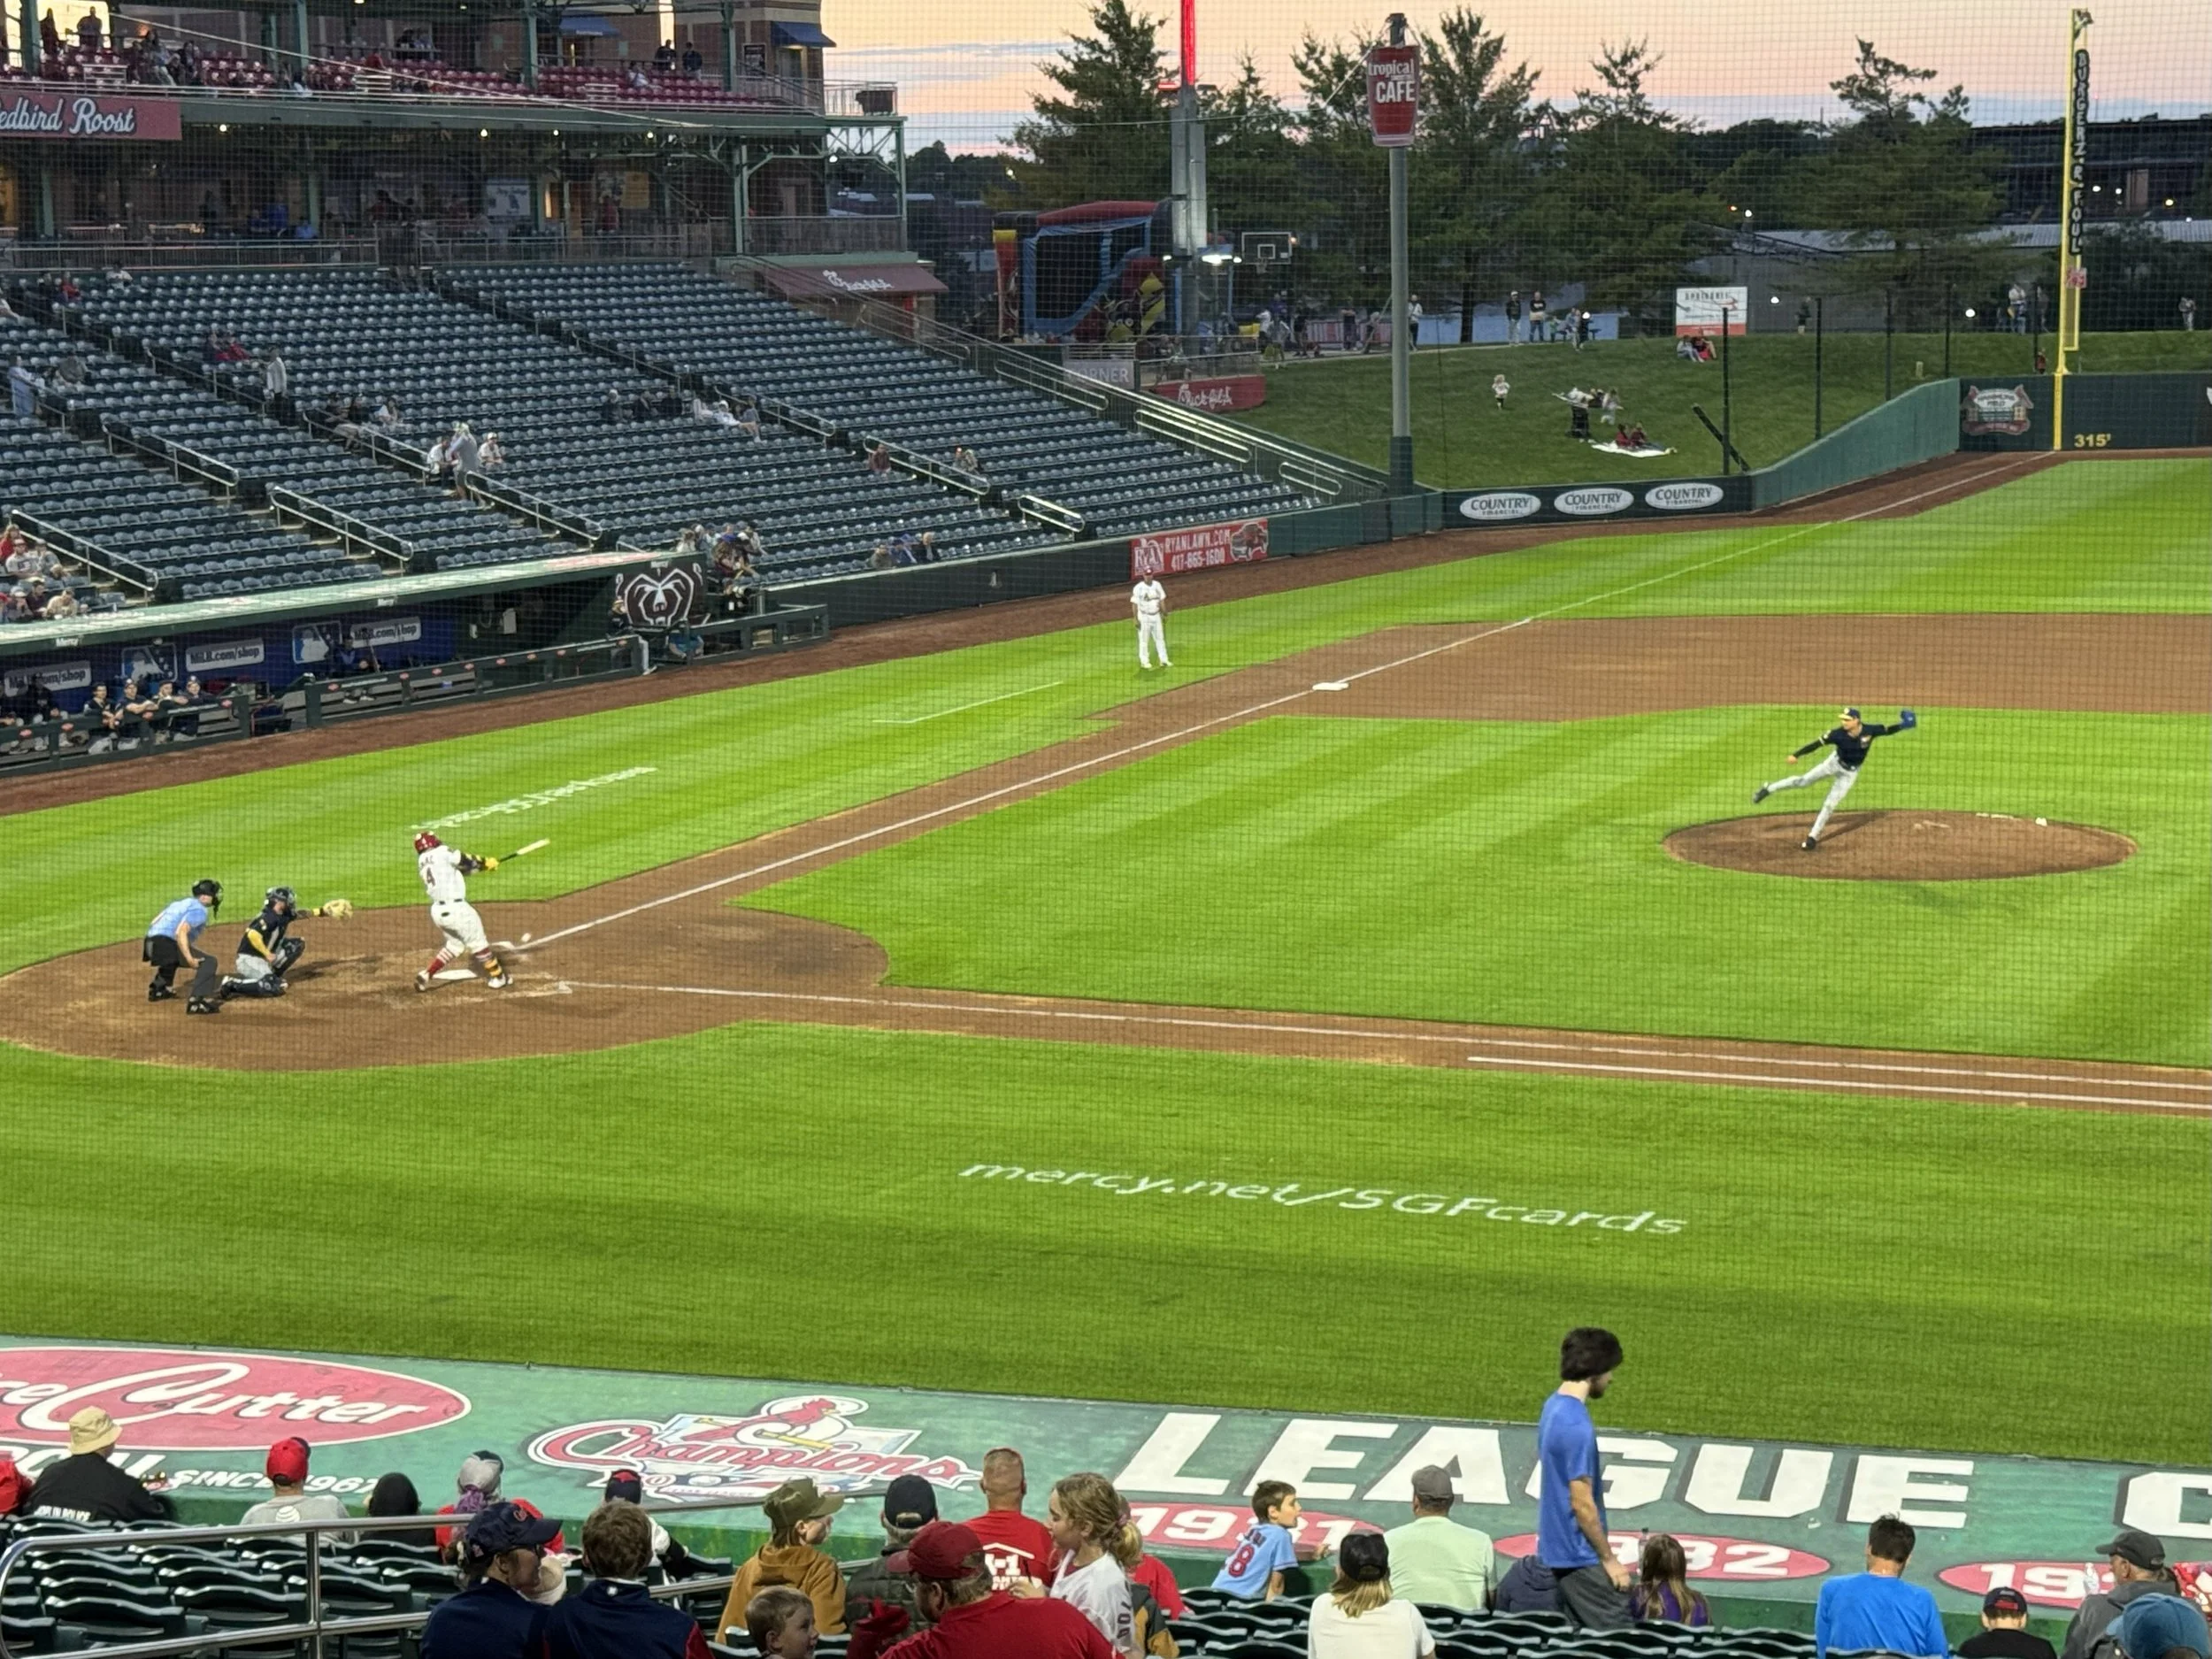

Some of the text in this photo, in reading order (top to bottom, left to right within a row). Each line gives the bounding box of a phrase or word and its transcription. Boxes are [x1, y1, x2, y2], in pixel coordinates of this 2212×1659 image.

[1368, 58, 1415, 78] tropical
[1376, 80, 1416, 104] CAFE
[0, 96, 135, 134] edbird Roost
[1067, 367, 1130, 383] ORNER
[1471, 497, 1530, 511] COUNTRY
[1564, 492, 1623, 506] COUNTRY
[1655, 487, 1713, 501] COUNTRY
[957, 1164, 1688, 1234] mercy.net/SGFcards
[20, 1362, 427, 1431] Cutter
[538, 1422, 964, 1481] Champions
[1112, 1412, 1975, 1529] LEAGUE
